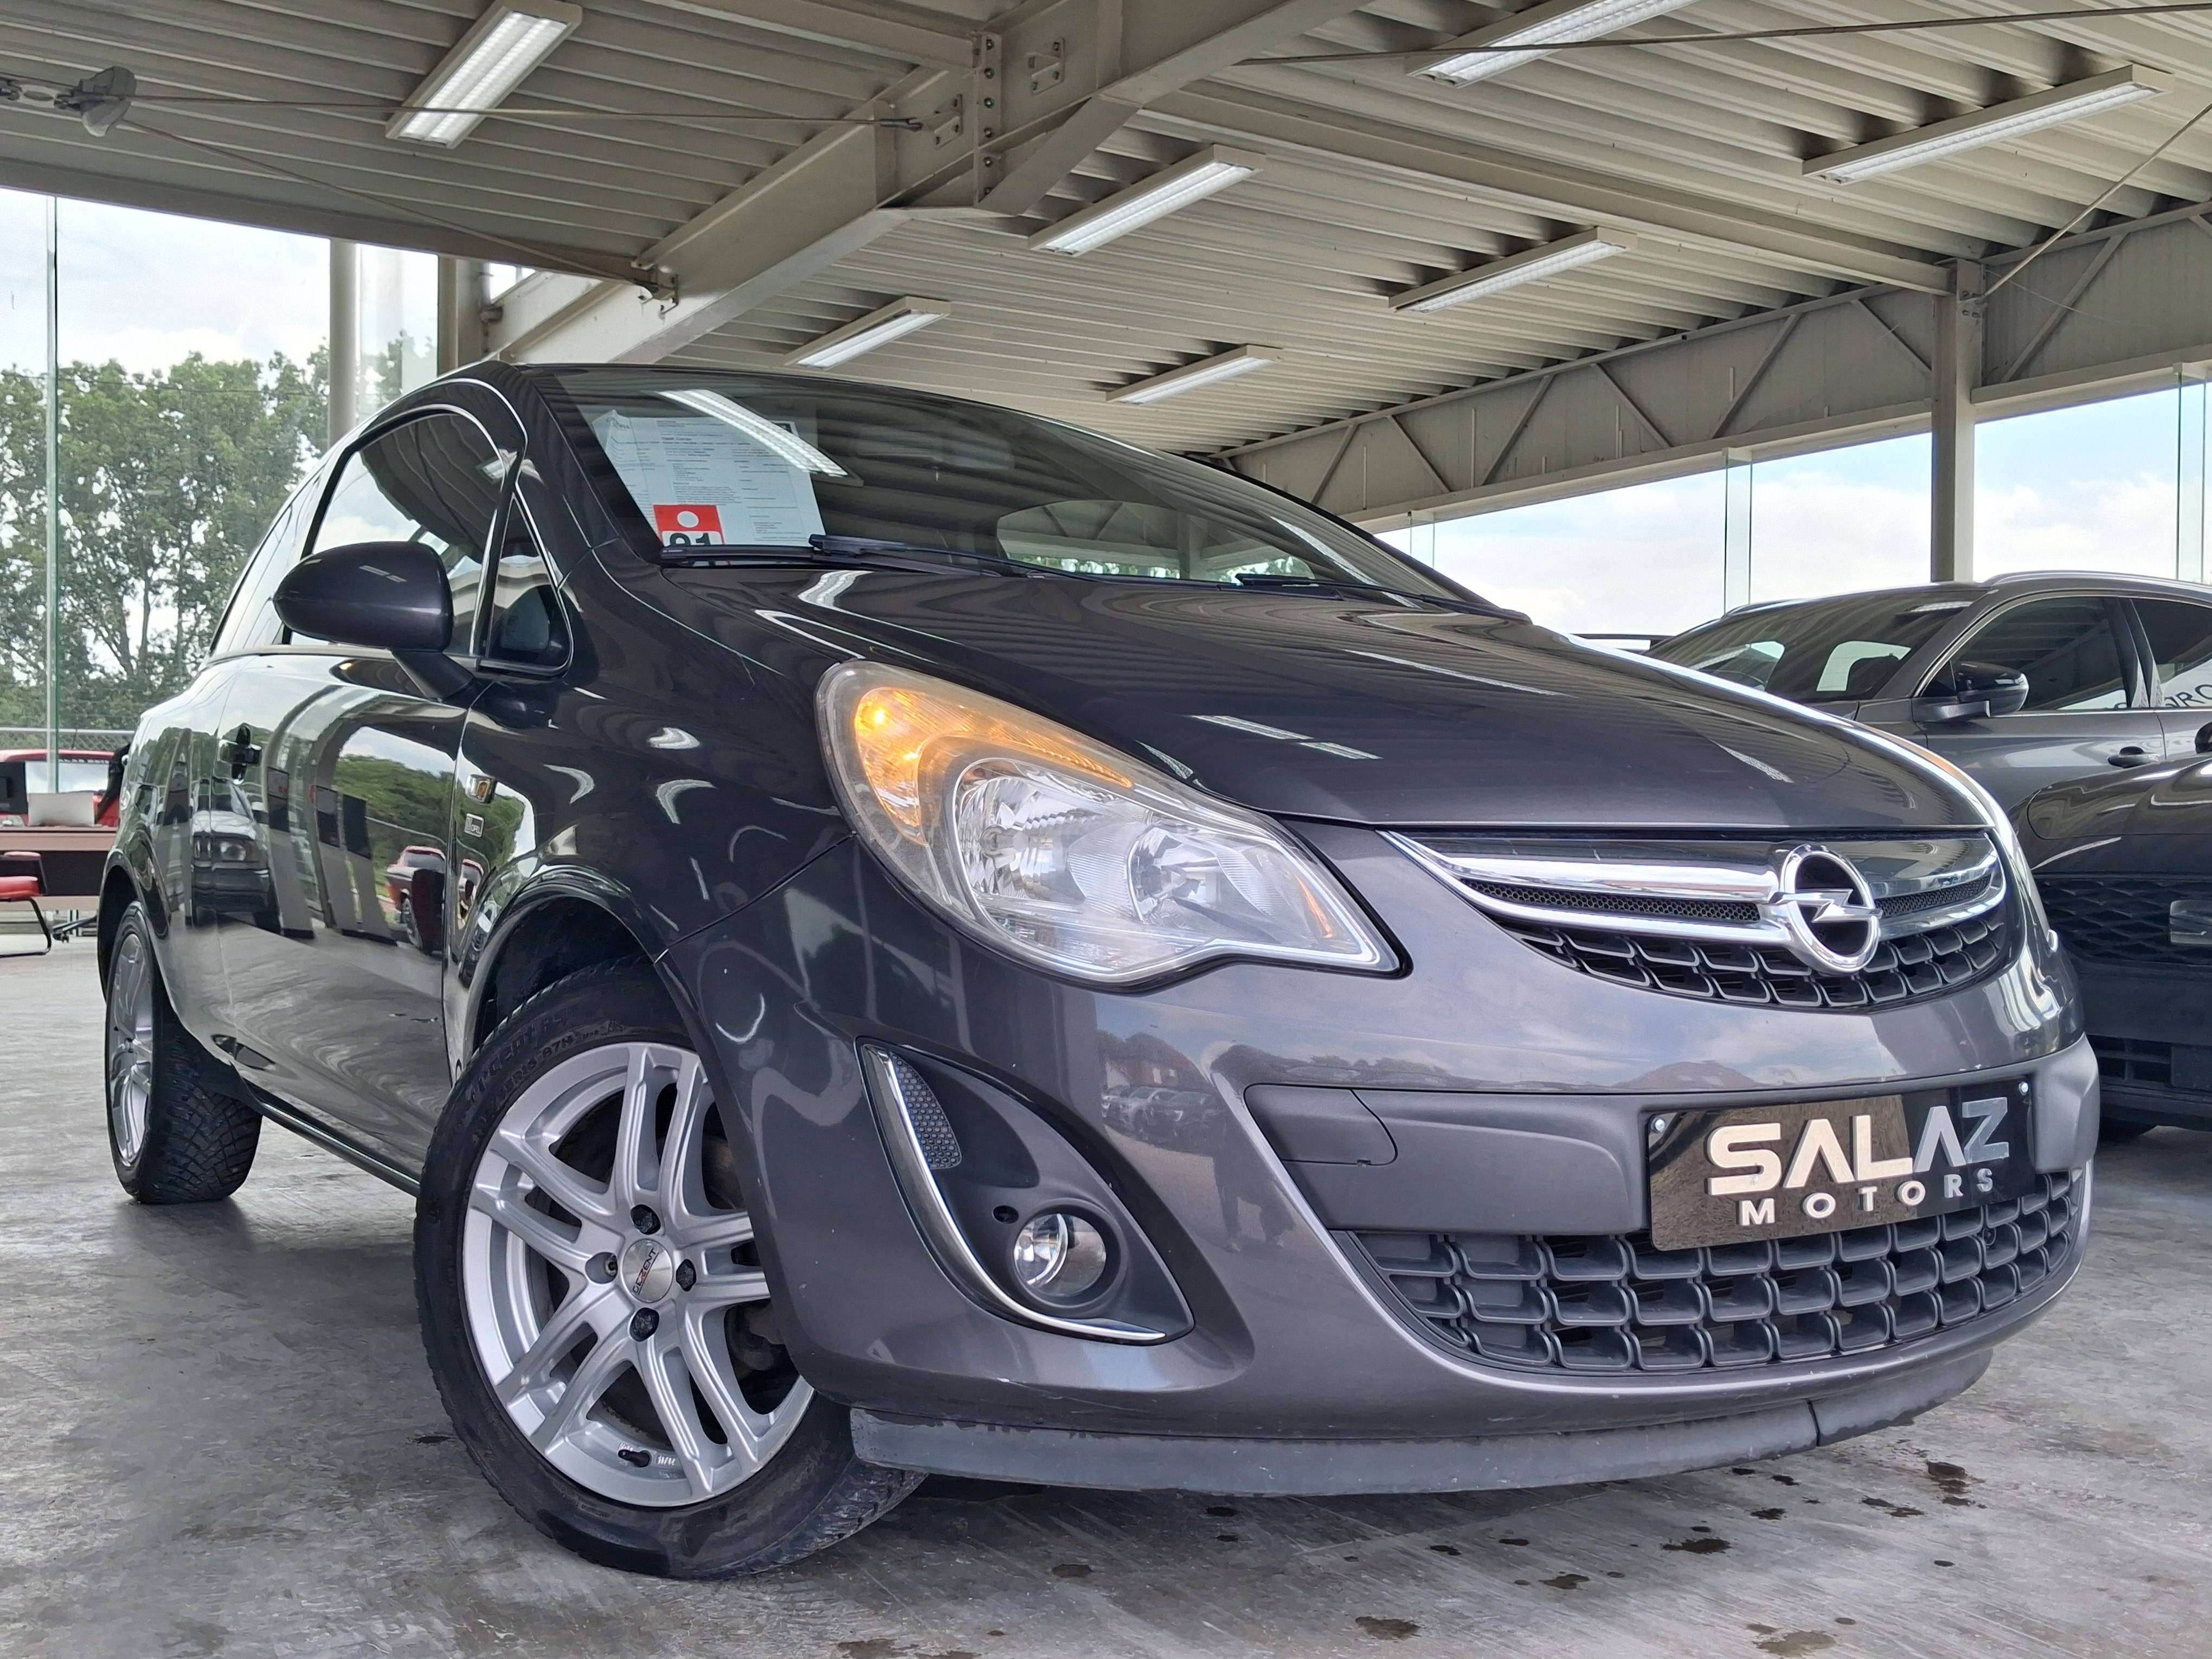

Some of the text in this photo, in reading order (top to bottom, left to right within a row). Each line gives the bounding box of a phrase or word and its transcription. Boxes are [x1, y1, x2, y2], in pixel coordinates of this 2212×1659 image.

[1708, 1097, 2009, 1196] SALAZ
[1739, 1168, 1993, 1226] MOTORS
[632, 1247, 656, 1294] DEZENT
